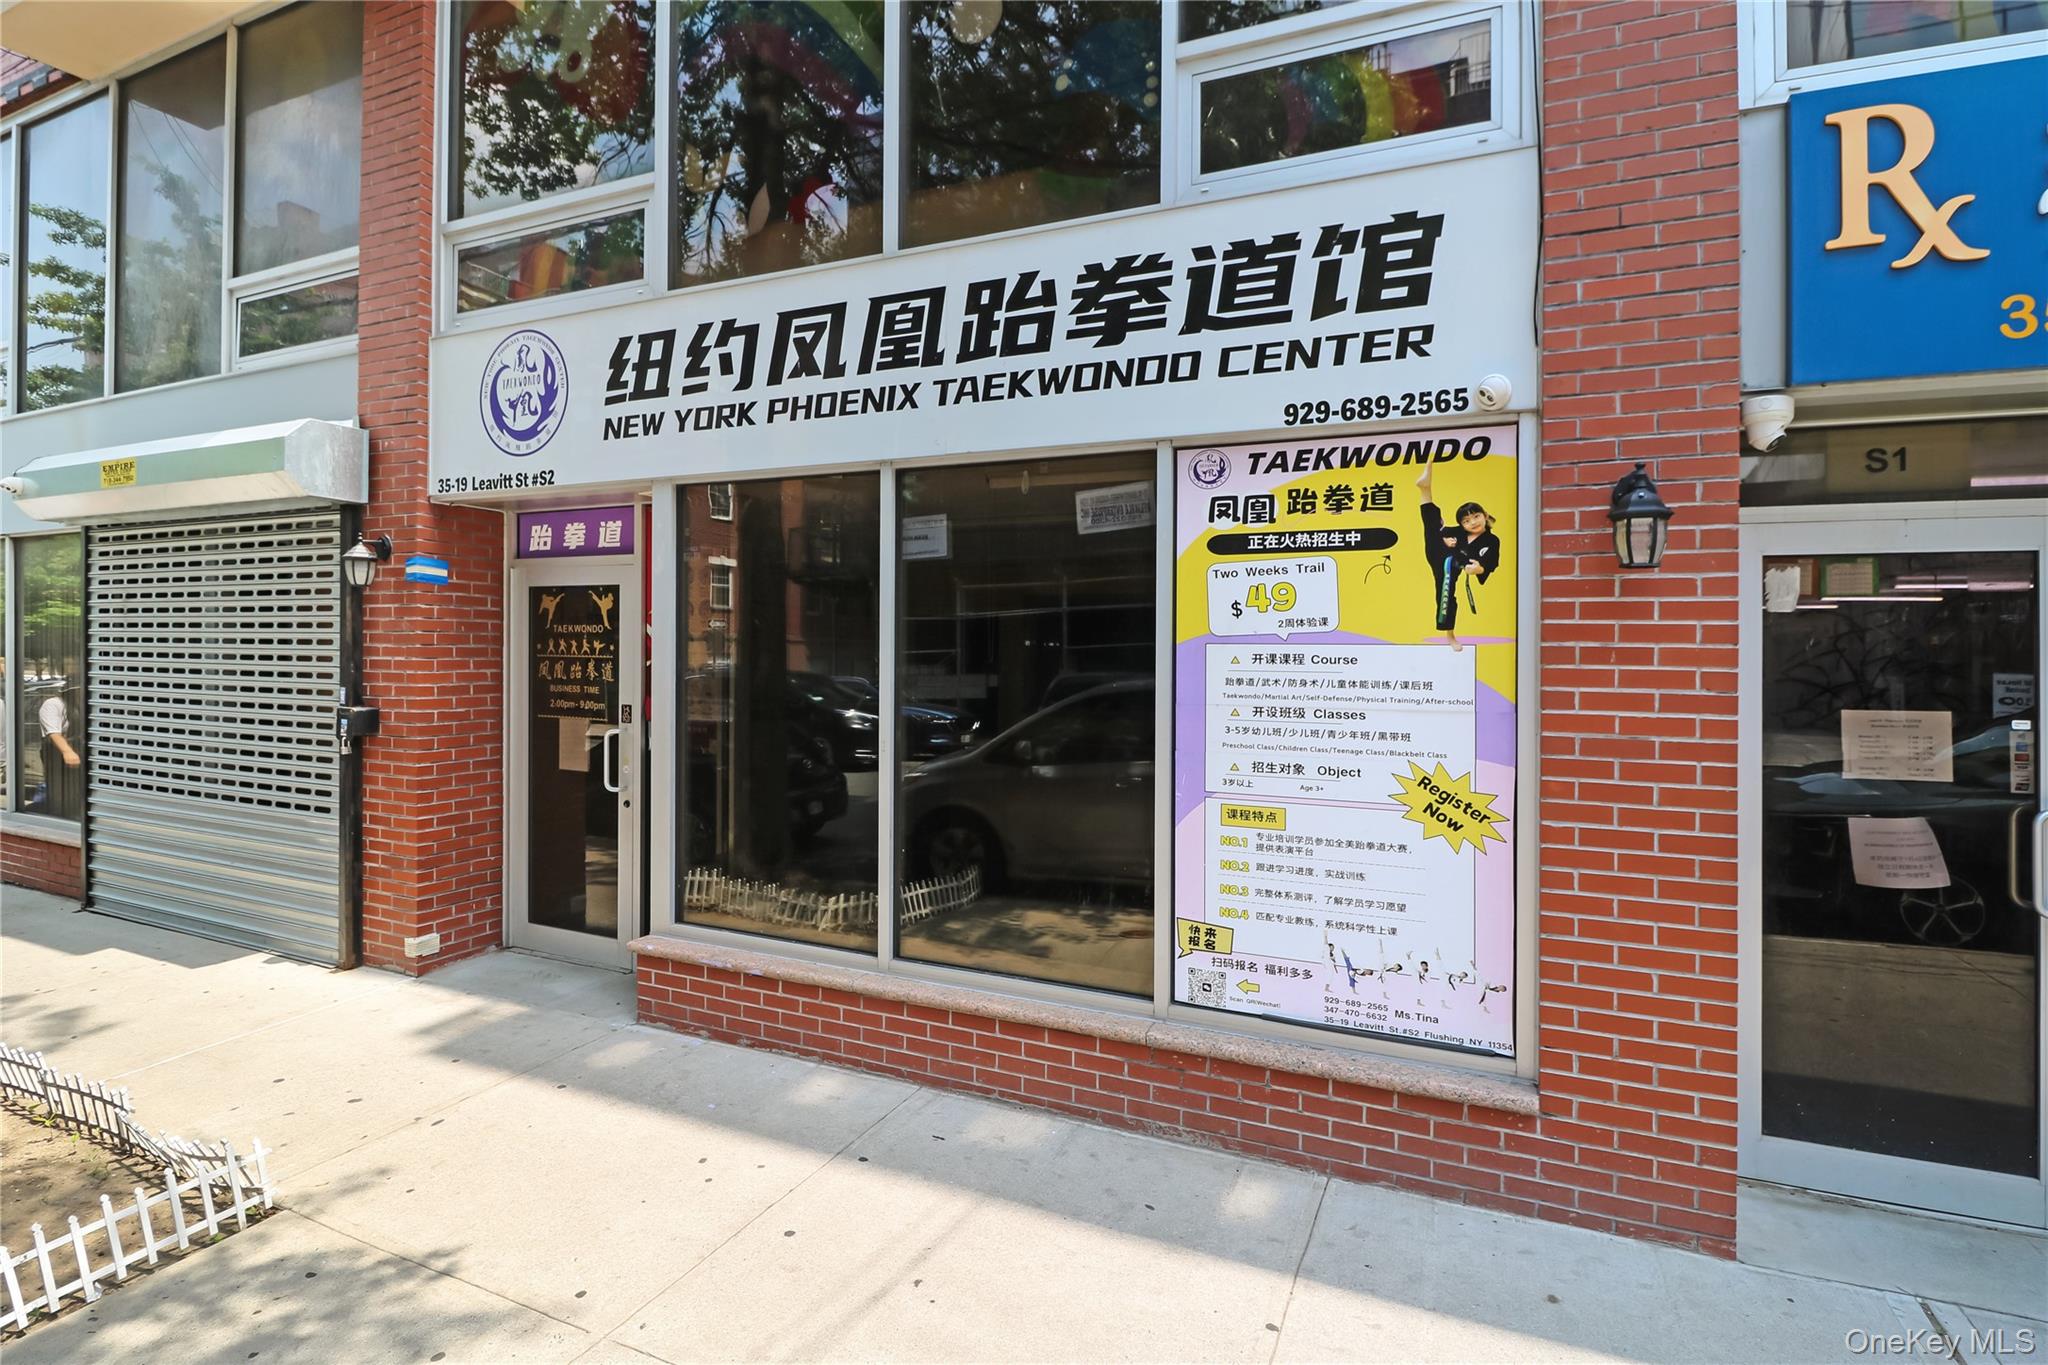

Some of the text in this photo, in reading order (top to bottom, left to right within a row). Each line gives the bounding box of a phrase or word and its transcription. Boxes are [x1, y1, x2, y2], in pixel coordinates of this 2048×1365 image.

[1824, 104, 1990, 269] Rx
[604, 210, 1445, 406] 纽约凤凰跆拳道馆
[2000, 294, 2048, 339] 3
[603, 411, 663, 440] NEW
[675, 402, 758, 435] YORK
[766, 382, 923, 424] PHOENIX
[934, 350, 1202, 406] TAEKWONDO
[1218, 323, 1435, 378] CENTER
[1283, 386, 1469, 426] 929-689-2565
[1248, 436, 1492, 476] TAEKWONDO
[1864, 447, 1908, 473] S1
[103, 461, 135, 472] EMPIRE
[438, 469, 555, 493] 35-19 Leavitt St #S2
[1208, 483, 1395, 525] 凤凰 跆拳道
[529, 520, 622, 551] 跆拳道
[1247, 532, 1361, 550] 正在火热招生中
[1213, 562, 1325, 579] Two Weeks Trail
[553, 624, 604, 633] TAEKWONDO
[1278, 617, 1329, 628] 2周体验课
[1251, 653, 1358, 665] 开课课程 Course
[550, 685, 600, 694] BUSINESS TIME
[1252, 706, 1366, 720] 开设班级 Classes
[1222, 742, 1255, 750] Preschool
[1257, 743, 1308, 753] Class/Children
[1310, 746, 1364, 755] Class/Teenage
[1252, 761, 1362, 779] 招生对象 Object
[1222, 778, 1254, 788] 3岁以上
[1417, 776, 1491, 824] Register
[1226, 808, 1278, 823] 课程特点
[1422, 802, 1464, 832] Now
[1220, 835, 1248, 848] NO.1
[1256, 843, 1314, 857] 提供表演平台
[1219, 859, 1250, 873] NO.2
[1219, 883, 1249, 897] NO.3
[1219, 906, 1249, 920] NO.4
[1212, 957, 1313, 980] 扫码报名 福利多多
[1324, 996, 1389, 1012] 929-689-2565
[1324, 1006, 1439, 1024] 347-470-6632 Ms.Tina
[1324, 1016, 1349, 1026] 35-19
[1353, 1020, 1384, 1032] Leavitt
[1424, 1031, 1464, 1045] Flushing
[1469, 1038, 1483, 1046] NY
[1488, 1041, 1513, 1051] 11354
